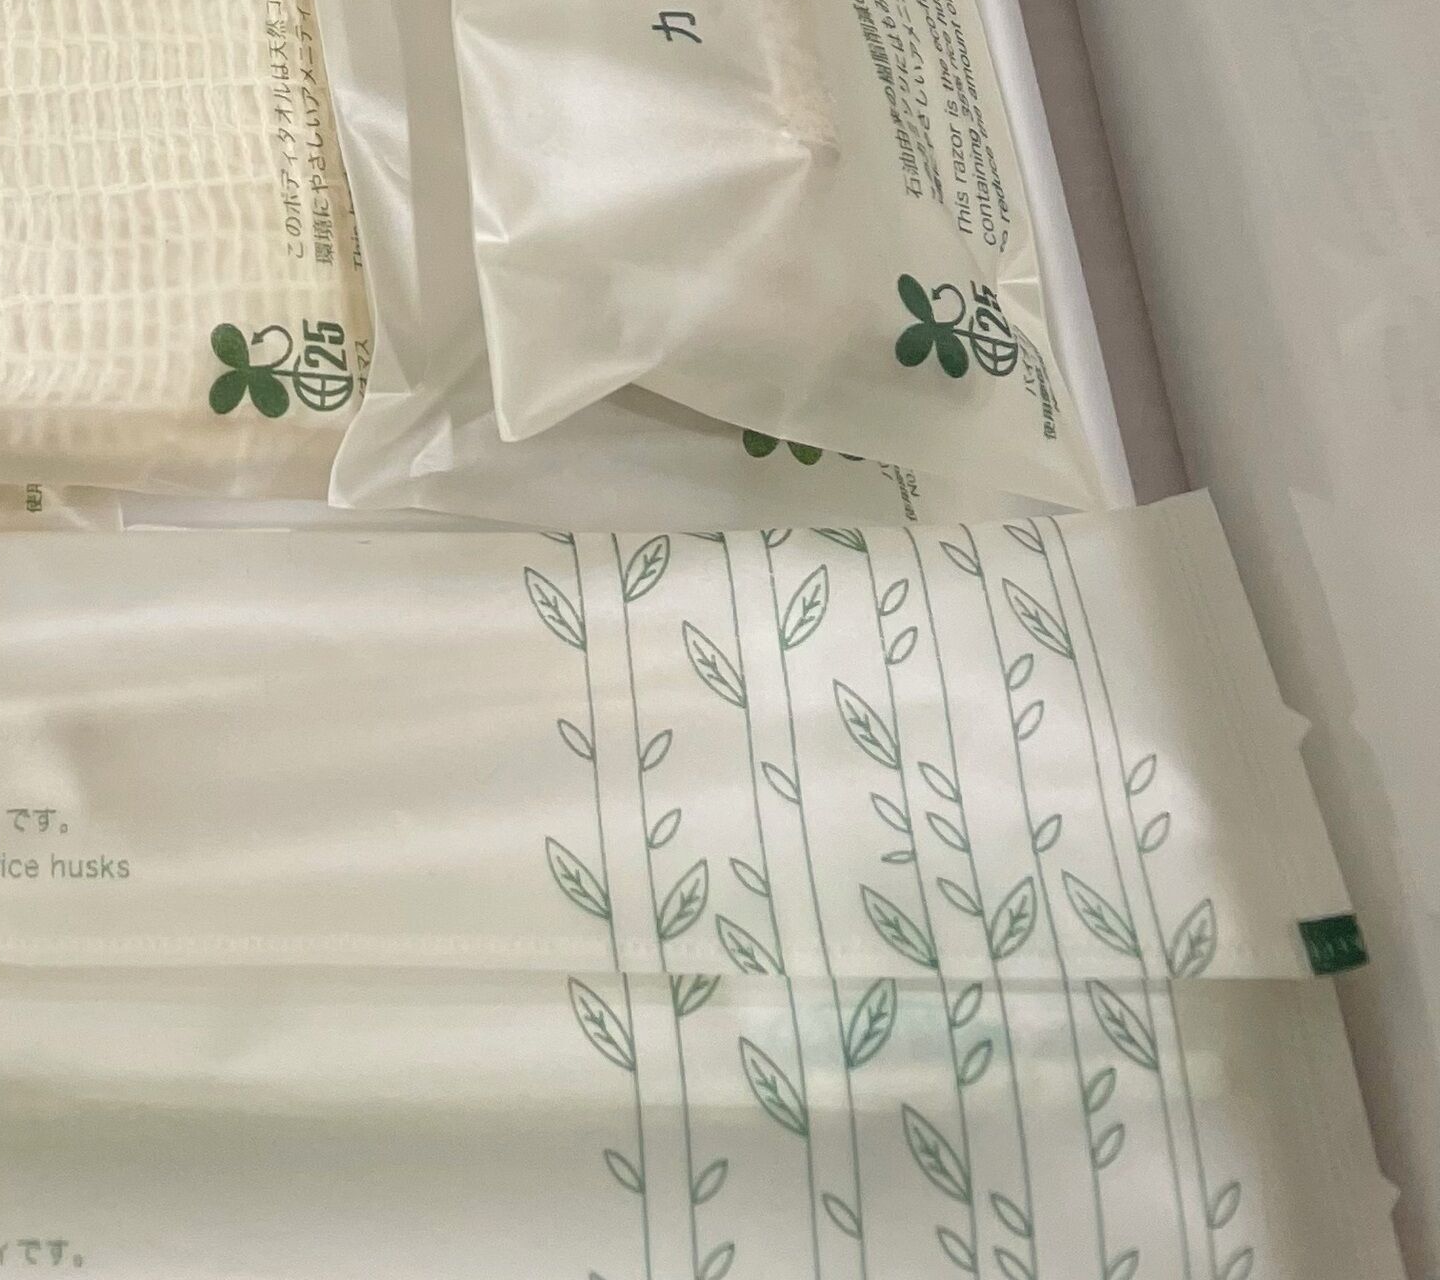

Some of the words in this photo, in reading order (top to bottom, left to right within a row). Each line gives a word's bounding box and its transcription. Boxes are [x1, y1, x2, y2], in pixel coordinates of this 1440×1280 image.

[938, 58, 955, 91] the
[951, 20, 979, 101] amount
[943, 99, 959, 118] is
[949, 122, 968, 184] razor
[968, 127, 998, 246] containing
[985, 145, 1011, 224] reduce
[954, 190, 974, 234] This
[302, 318, 348, 372] 25
[50, 853, 131, 879] husks
